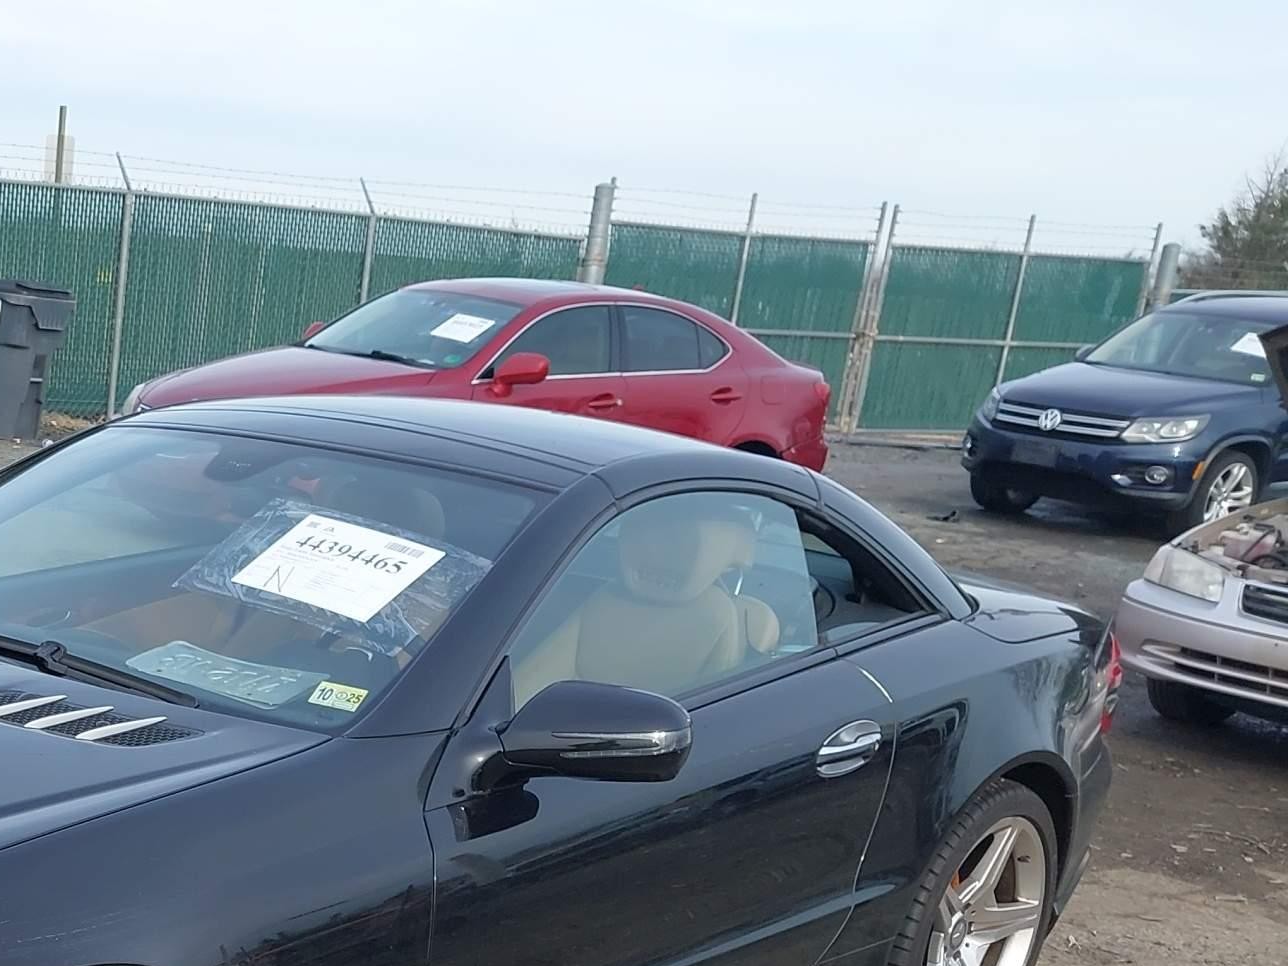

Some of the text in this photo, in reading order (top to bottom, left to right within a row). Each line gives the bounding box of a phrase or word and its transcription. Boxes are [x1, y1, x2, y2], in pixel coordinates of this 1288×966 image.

[295, 535, 408, 574] 44394465
[316, 687, 363, 704] 10 25
